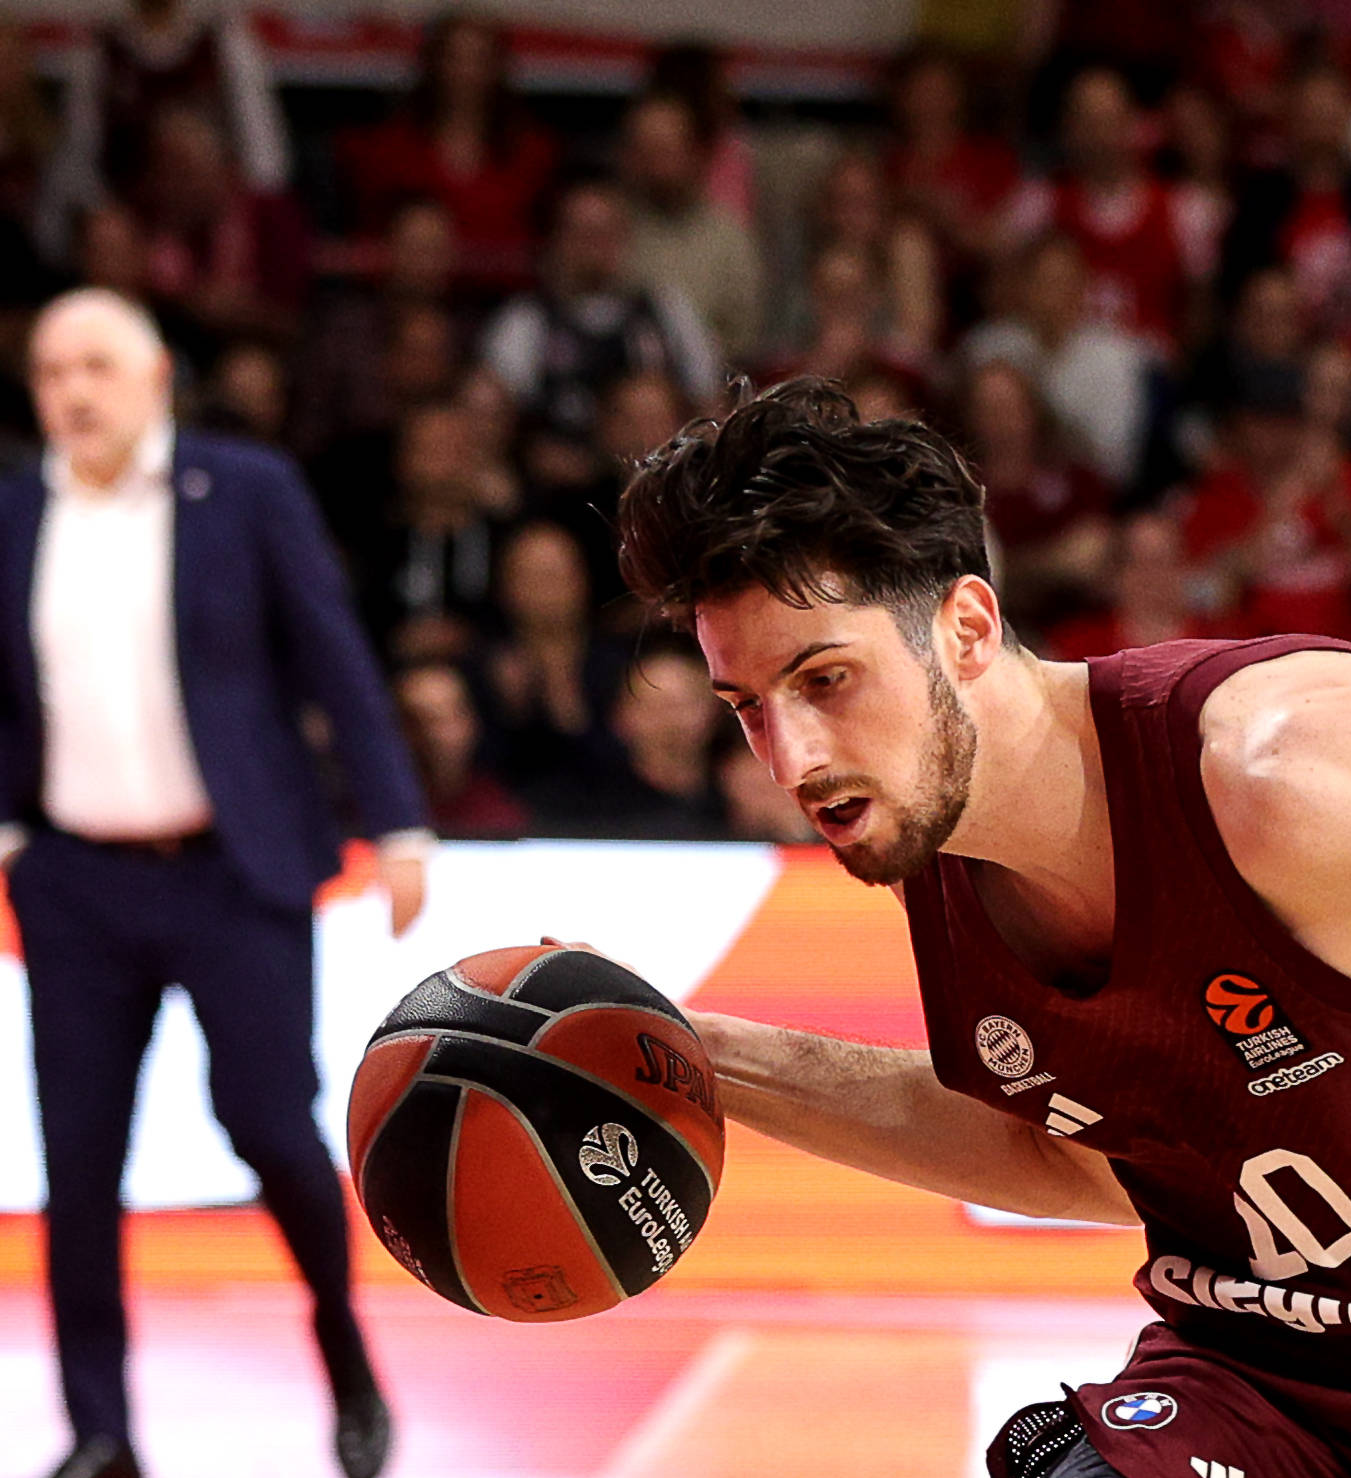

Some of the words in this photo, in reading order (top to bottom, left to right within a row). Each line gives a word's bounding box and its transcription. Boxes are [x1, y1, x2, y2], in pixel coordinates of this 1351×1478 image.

[982, 1020, 1021, 1038] BAYERN
[1235, 1026, 1291, 1051] TURKISH
[1244, 1034, 1298, 1061] AIRLINES
[641, 1168, 690, 1239] TURKISH
